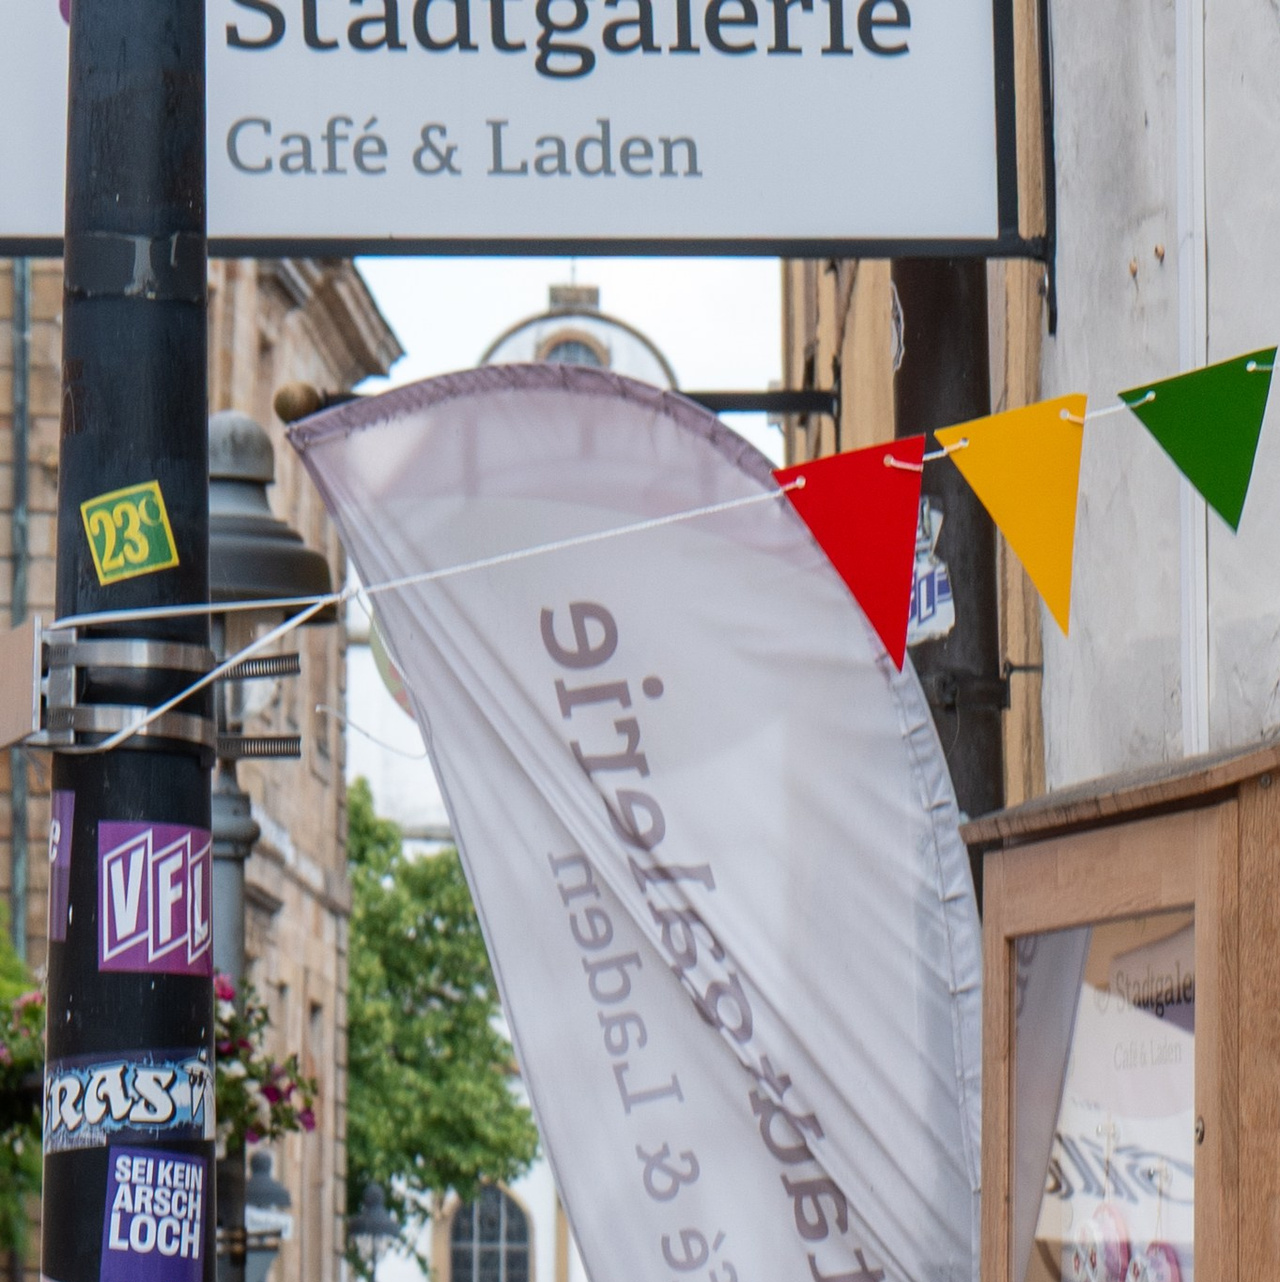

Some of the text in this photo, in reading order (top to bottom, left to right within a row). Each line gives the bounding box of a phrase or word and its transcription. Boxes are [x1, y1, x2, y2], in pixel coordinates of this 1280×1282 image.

[224, 0, 912, 78] Stadtgalerie
[224, 116, 704, 180] Café & Laden
[115, 1155, 203, 1191] SEI KEIN
[113, 1183, 202, 1220] ARSCH
[108, 1213, 200, 1260] LOCH
